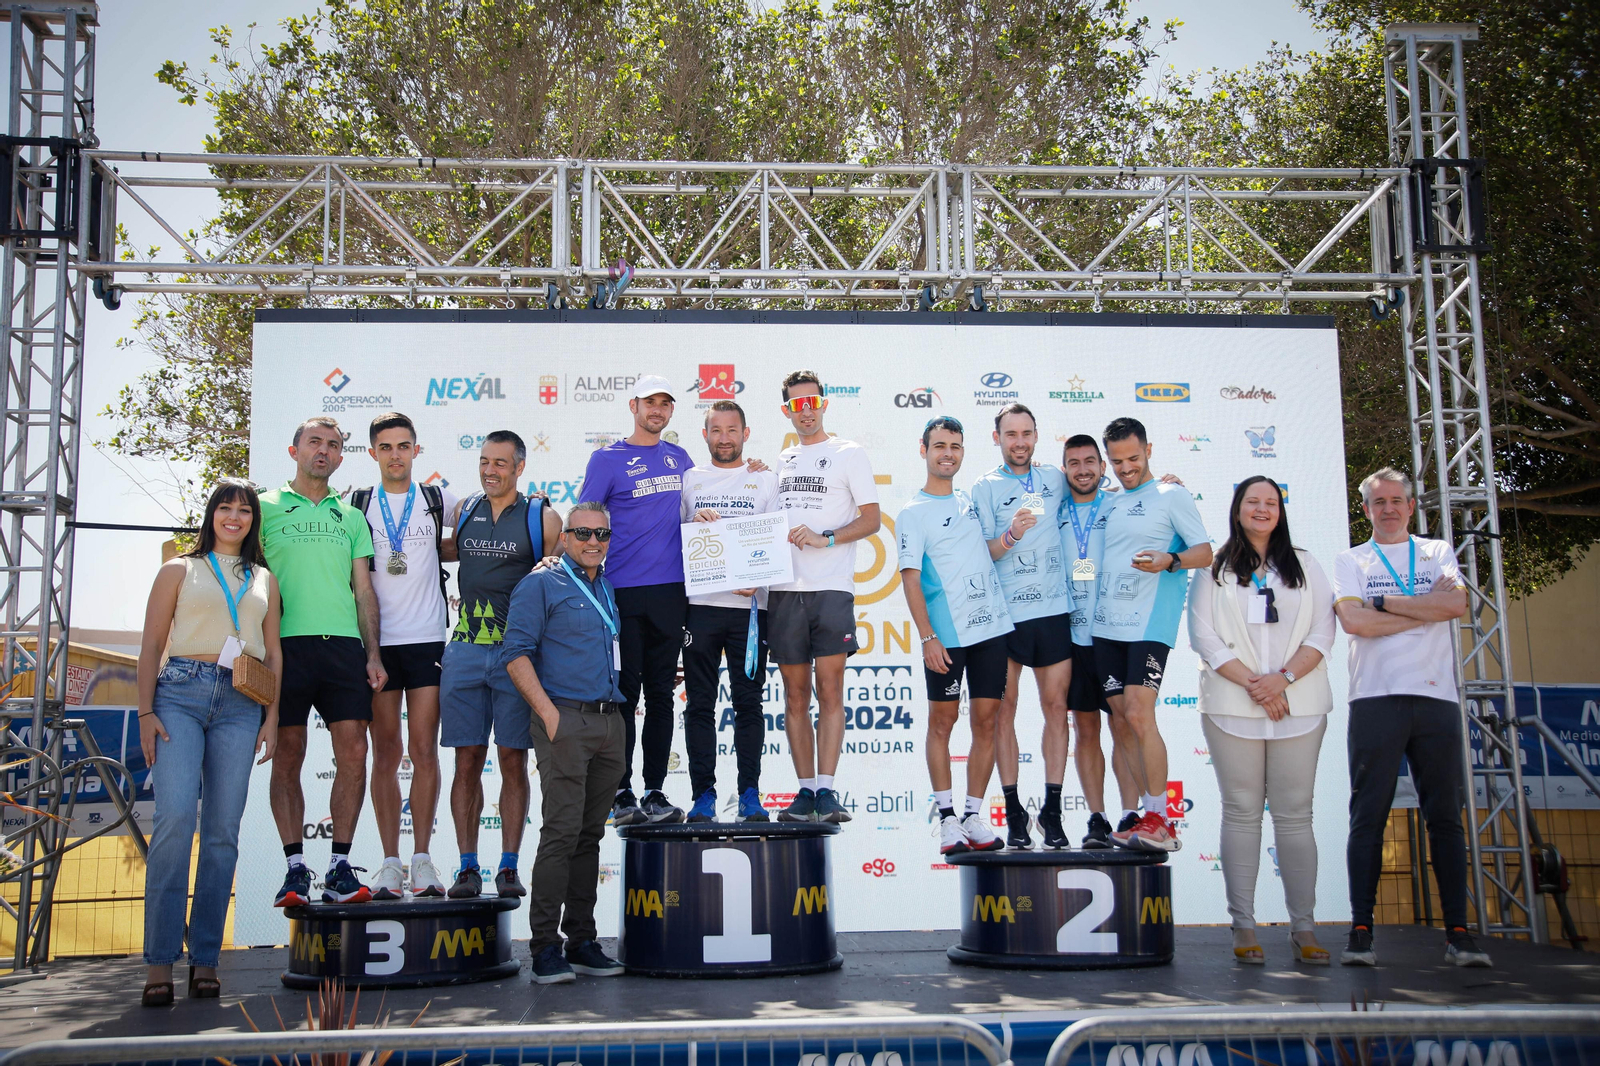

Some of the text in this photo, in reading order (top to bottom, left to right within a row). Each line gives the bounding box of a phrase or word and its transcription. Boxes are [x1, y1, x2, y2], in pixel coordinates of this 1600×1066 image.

[574, 392, 615, 402] CIUDAD
[823, 383, 861, 398] jamar
[1049, 391, 1104, 399] ESTRELLA
[1143, 387, 1186, 397] IKEA
[322, 394, 392, 404] COOPERACIÓN
[894, 393, 933, 409] CASI
[322, 404, 346, 412] 2005
[694, 501, 755, 509] Almería 2024
[726, 516, 785, 531] CHEQUE REGALO
[282, 522, 348, 540] CUELLAR
[739, 526, 773, 537] HYUNDAI
[326, 537, 344, 546] 1958
[463, 538, 517, 552] CUELLAR
[688, 534, 724, 561] 25
[689, 559, 726, 570] EDICIÓN
[1015, 567, 1037, 575] natural
[1072, 558, 1095, 575] 25
[840, 739, 914, 754] NDÚJAR
[866, 790, 913, 813] abril
[862, 858, 896, 877] ego
[665, 890, 680, 903] 25
[1016, 896, 1032, 908] 25
[702, 848, 771, 963] 1
[1056, 869, 1118, 953] 2
[327, 933, 342, 946] 25
[364, 919, 406, 976] 3
